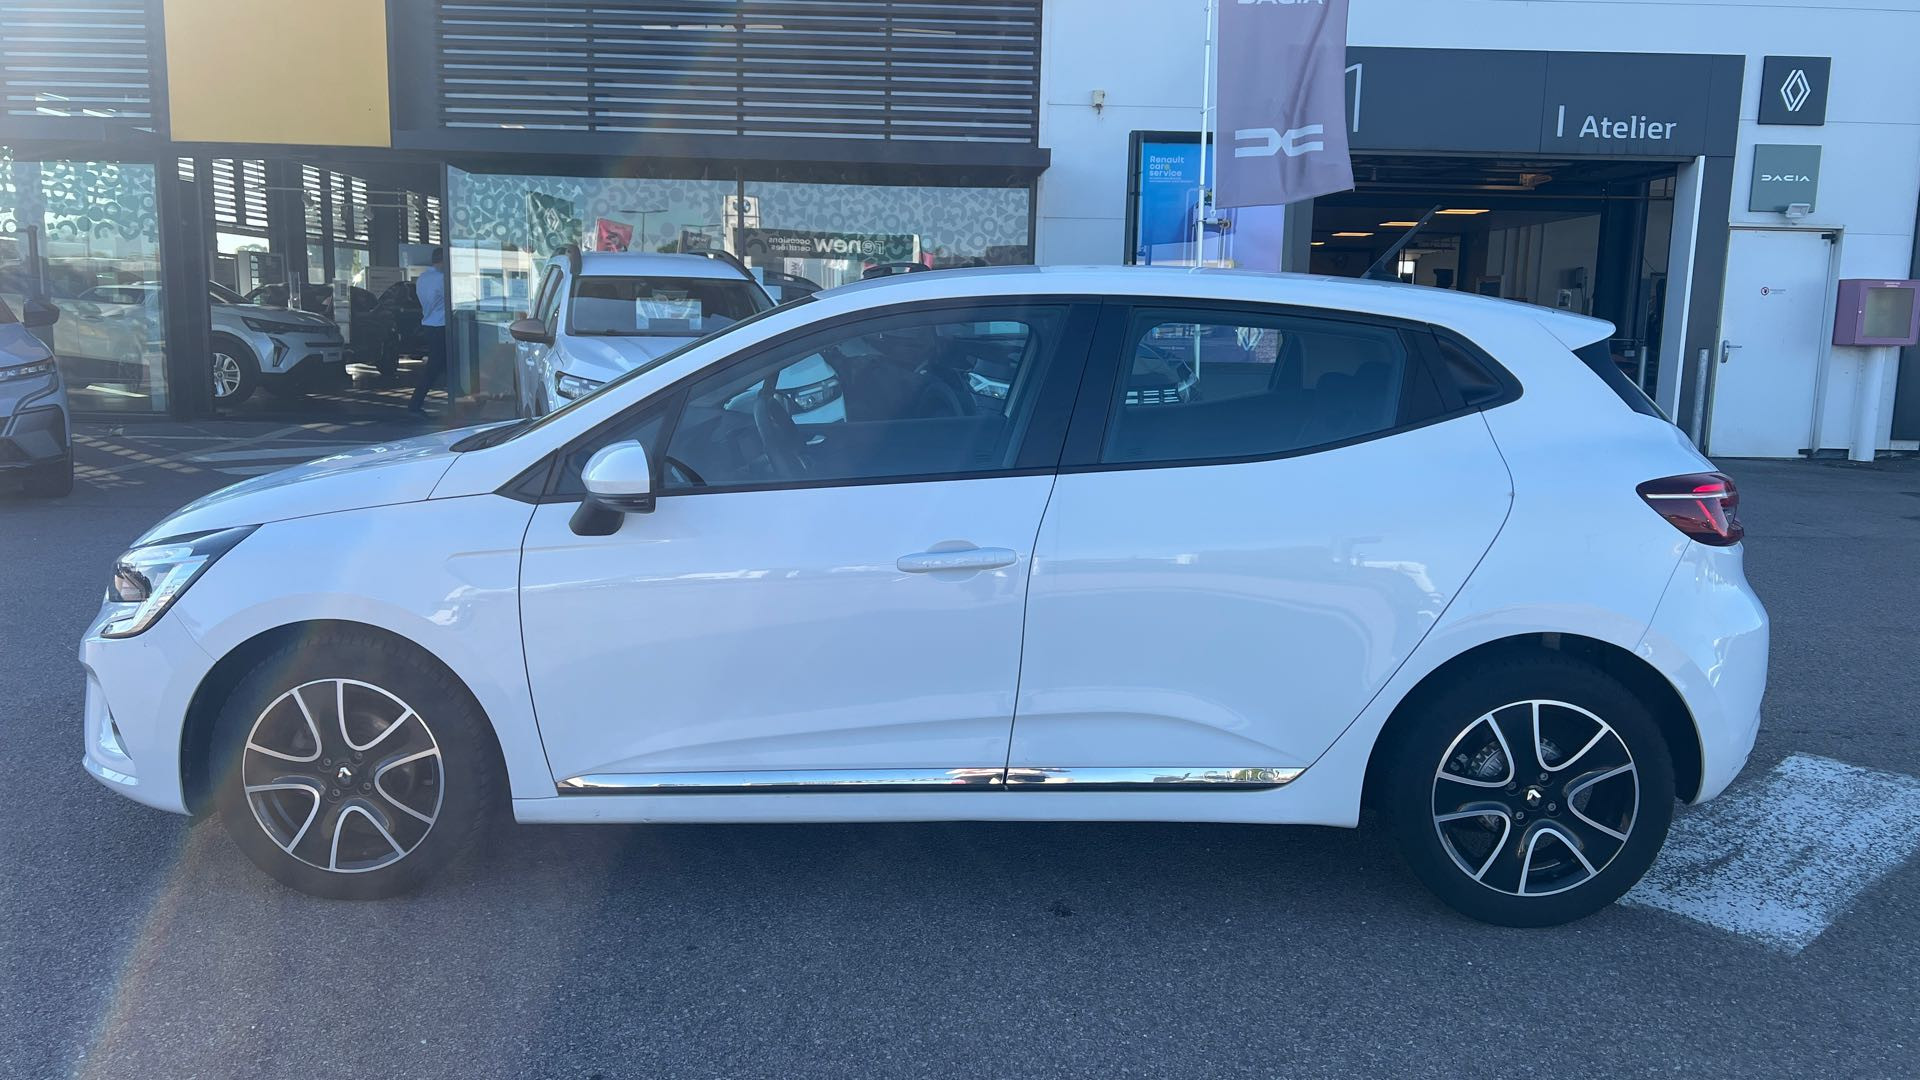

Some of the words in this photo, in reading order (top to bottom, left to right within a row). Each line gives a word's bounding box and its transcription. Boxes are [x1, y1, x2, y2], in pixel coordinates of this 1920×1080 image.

[1578, 115, 1677, 140] Atelier
[1150, 155, 1185, 163] Renault
[1761, 174, 1810, 182] DACIA
